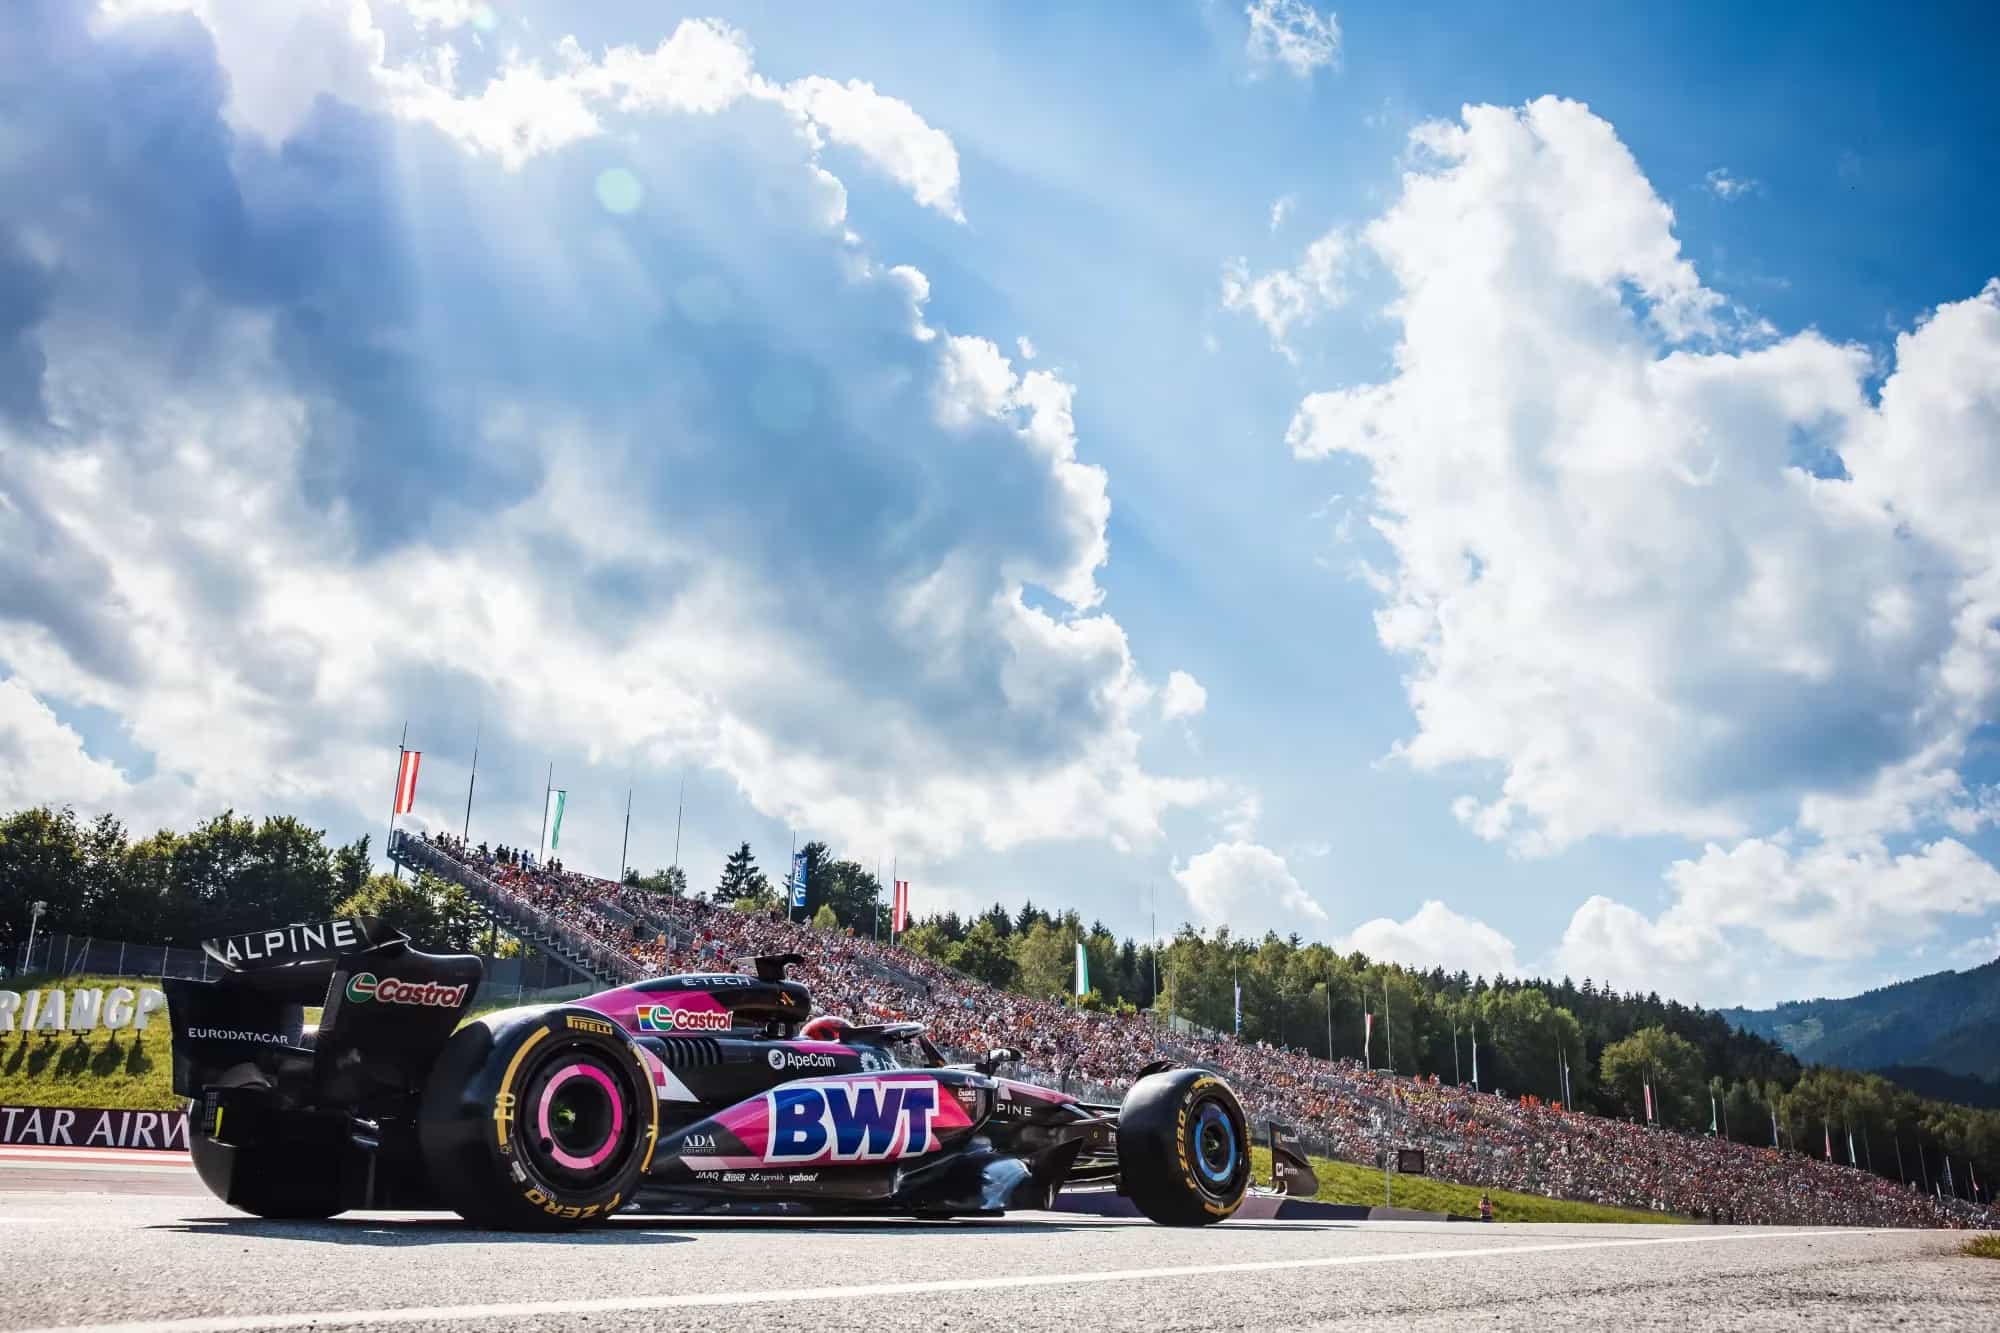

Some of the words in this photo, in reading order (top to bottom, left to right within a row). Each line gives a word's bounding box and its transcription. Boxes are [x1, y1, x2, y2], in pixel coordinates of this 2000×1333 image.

[226, 919, 358, 962] ALPINE
[375, 977, 468, 1007] Castrol
[682, 977, 751, 986] E-TECH
[566, 1015, 613, 1035] PIRELLI
[674, 1008, 733, 1031] Castrol
[188, 1027, 289, 1045] EURODATACAR
[787, 1053, 836, 1070] ApeCoin
[1, 1107, 74, 1145] TAR
[764, 1081, 938, 1163] BWT
[683, 1134, 716, 1147] ADA
[525, 1188, 600, 1218] ZERO
